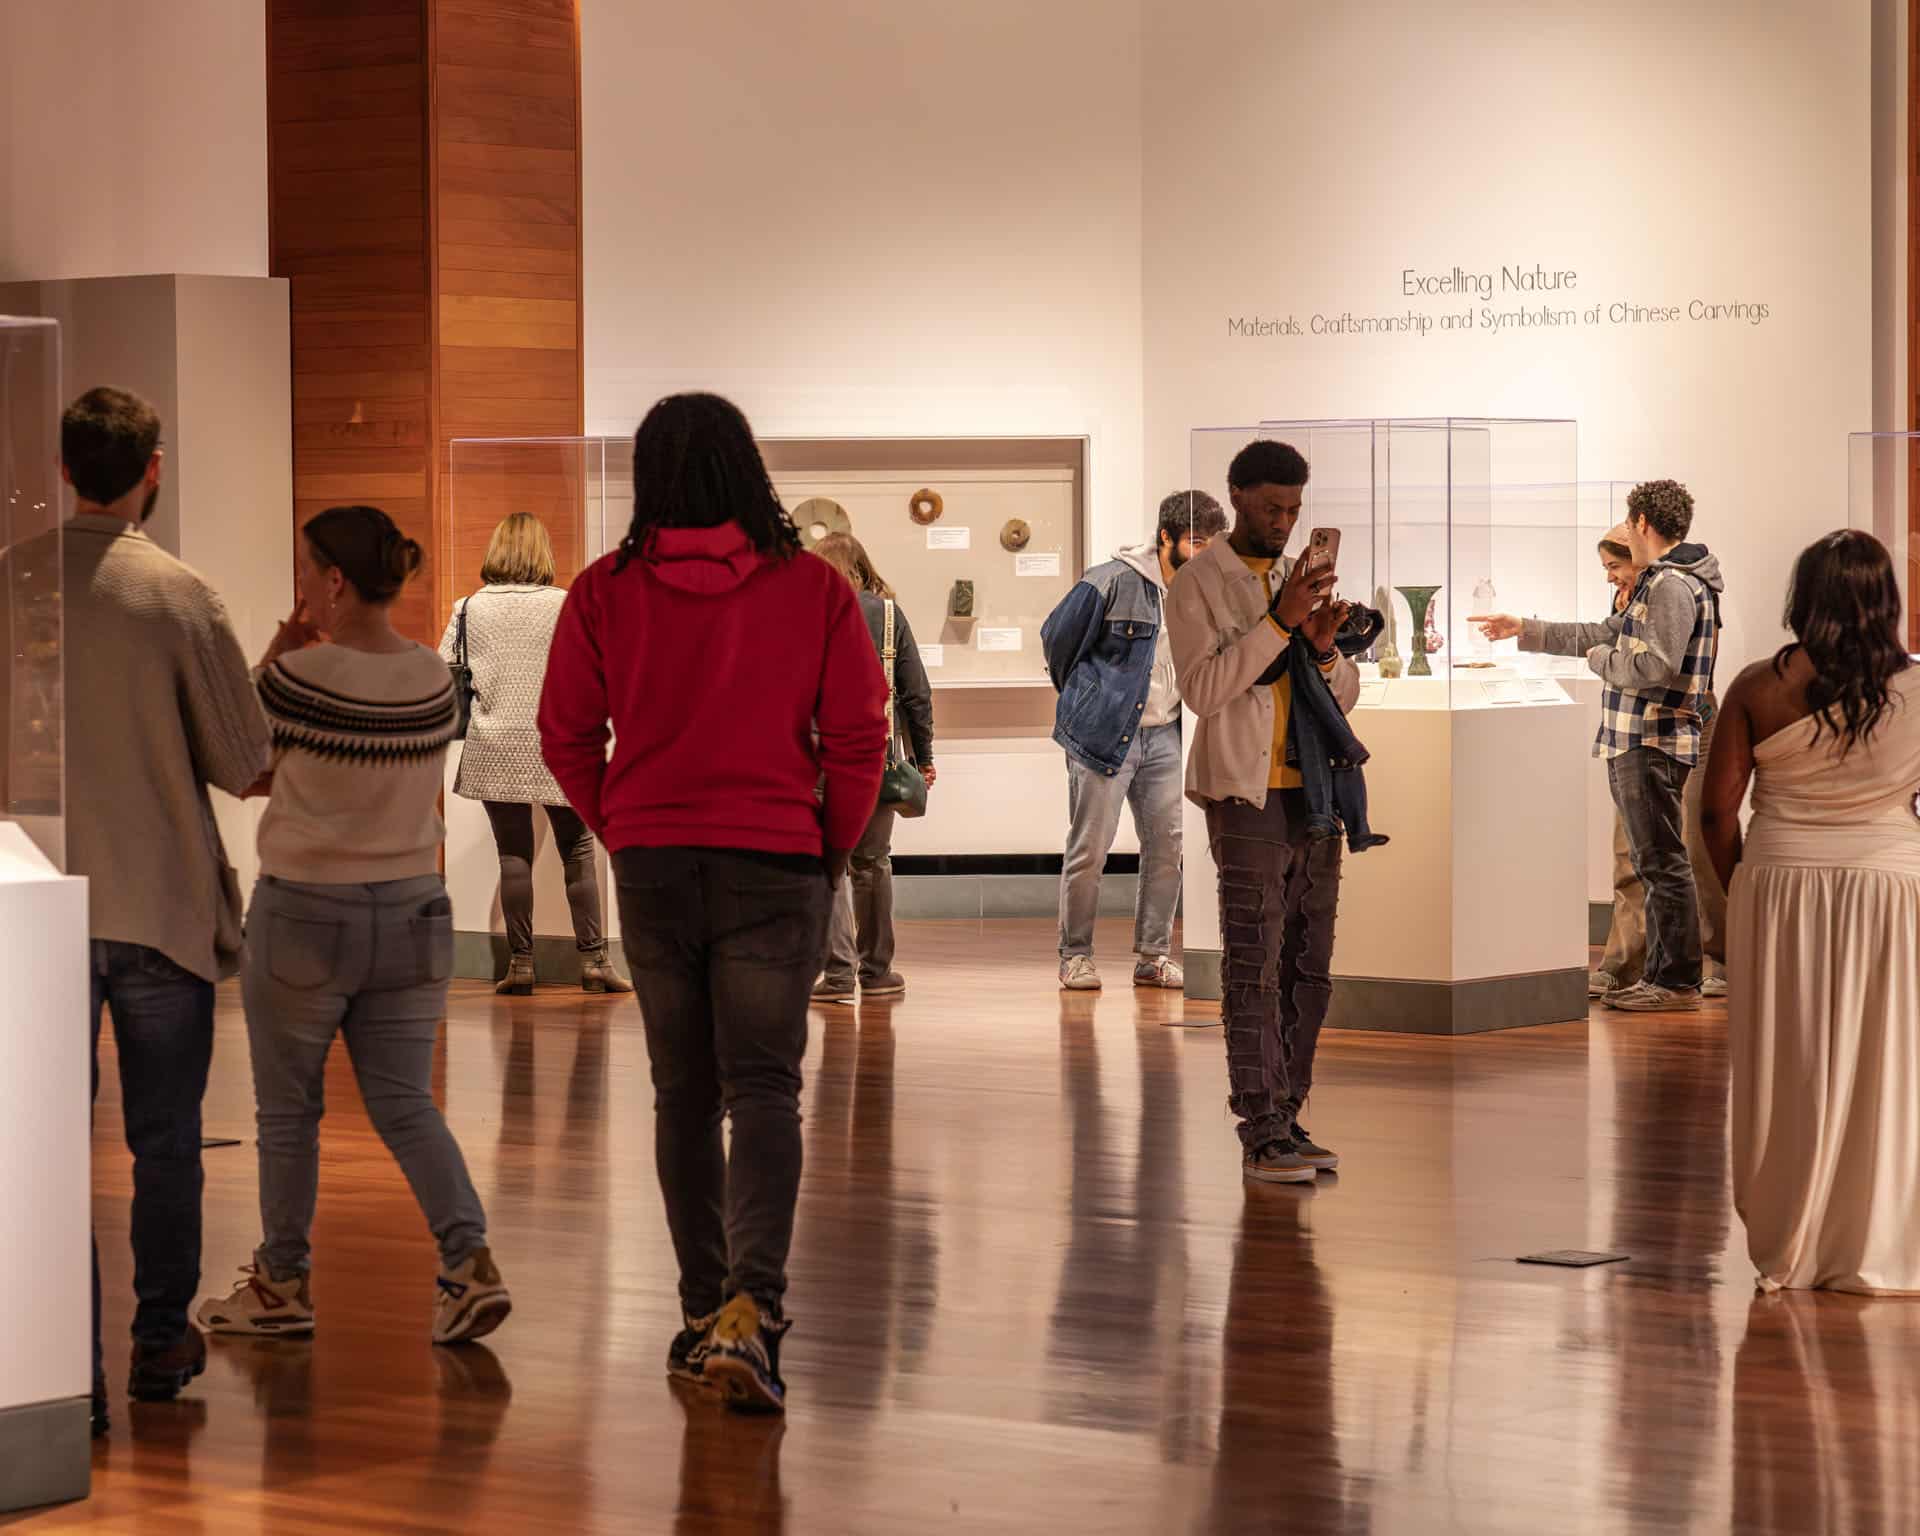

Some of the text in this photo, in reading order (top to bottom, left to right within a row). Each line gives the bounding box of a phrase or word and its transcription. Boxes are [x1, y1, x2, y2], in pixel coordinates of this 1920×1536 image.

[1402, 263, 1577, 302] Excelling Nature
[1310, 309, 1433, 336] Craftsmanship
[1440, 307, 1473, 330] and
[1480, 305, 1577, 335] Symbolism
[1584, 303, 1602, 325] of
[1608, 301, 1681, 324] Chinese
[1688, 299, 1770, 326] Carvings
